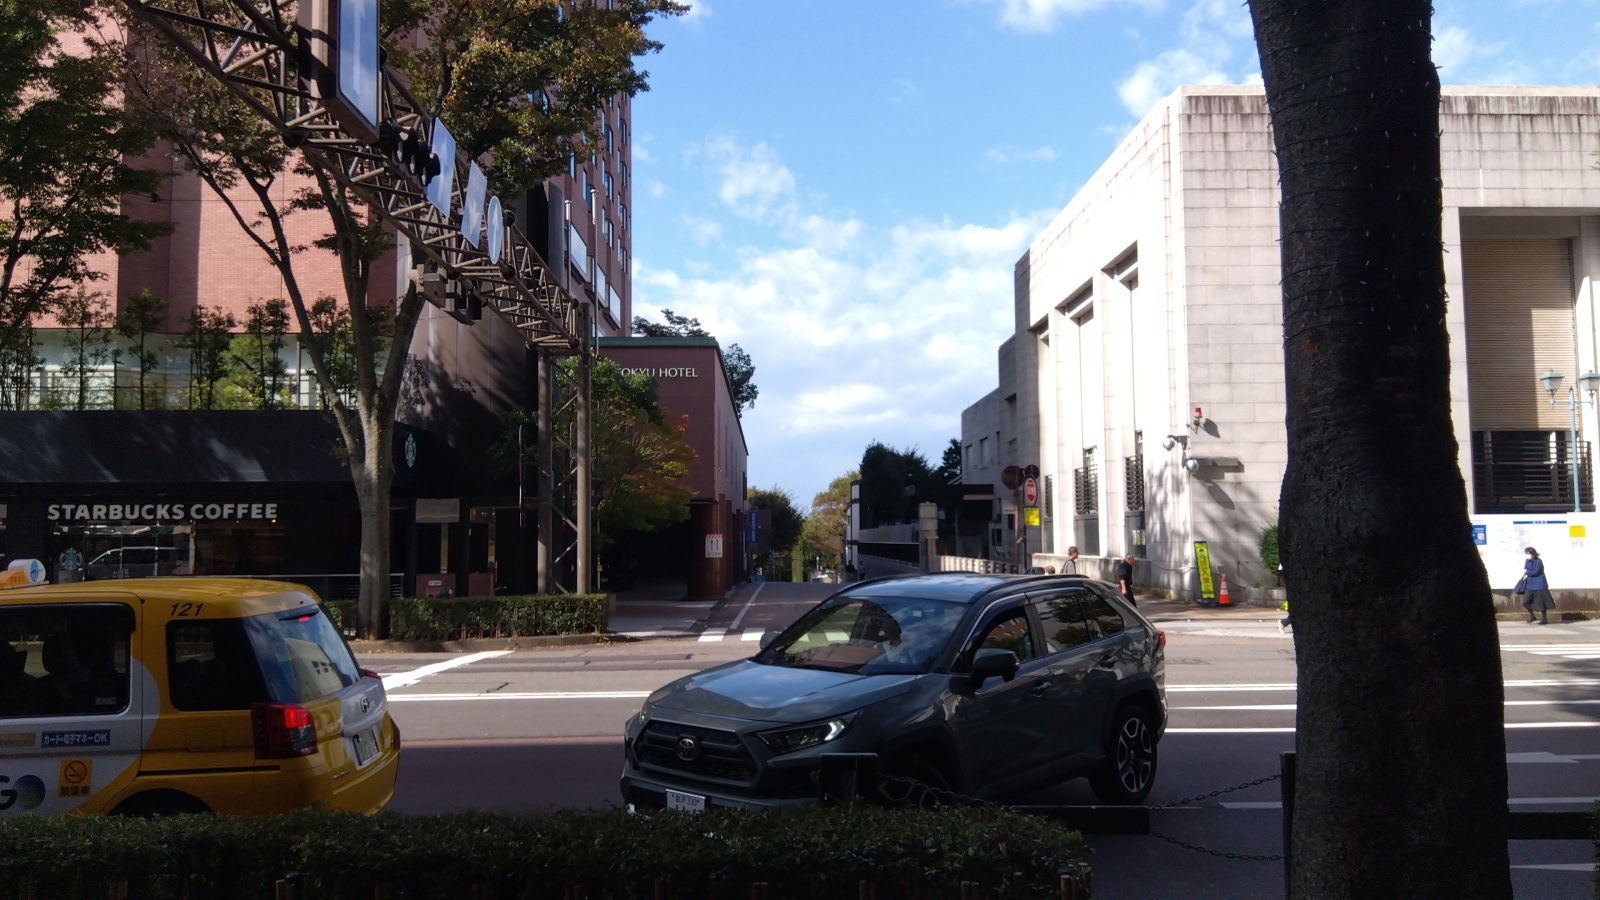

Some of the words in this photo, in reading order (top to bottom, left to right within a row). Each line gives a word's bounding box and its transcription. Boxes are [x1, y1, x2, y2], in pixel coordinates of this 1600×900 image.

[659, 367, 698, 378] HOTEL
[48, 504, 185, 520] STARBUCKS
[190, 503, 277, 520] COFFEE
[171, 602, 204, 617] 121
